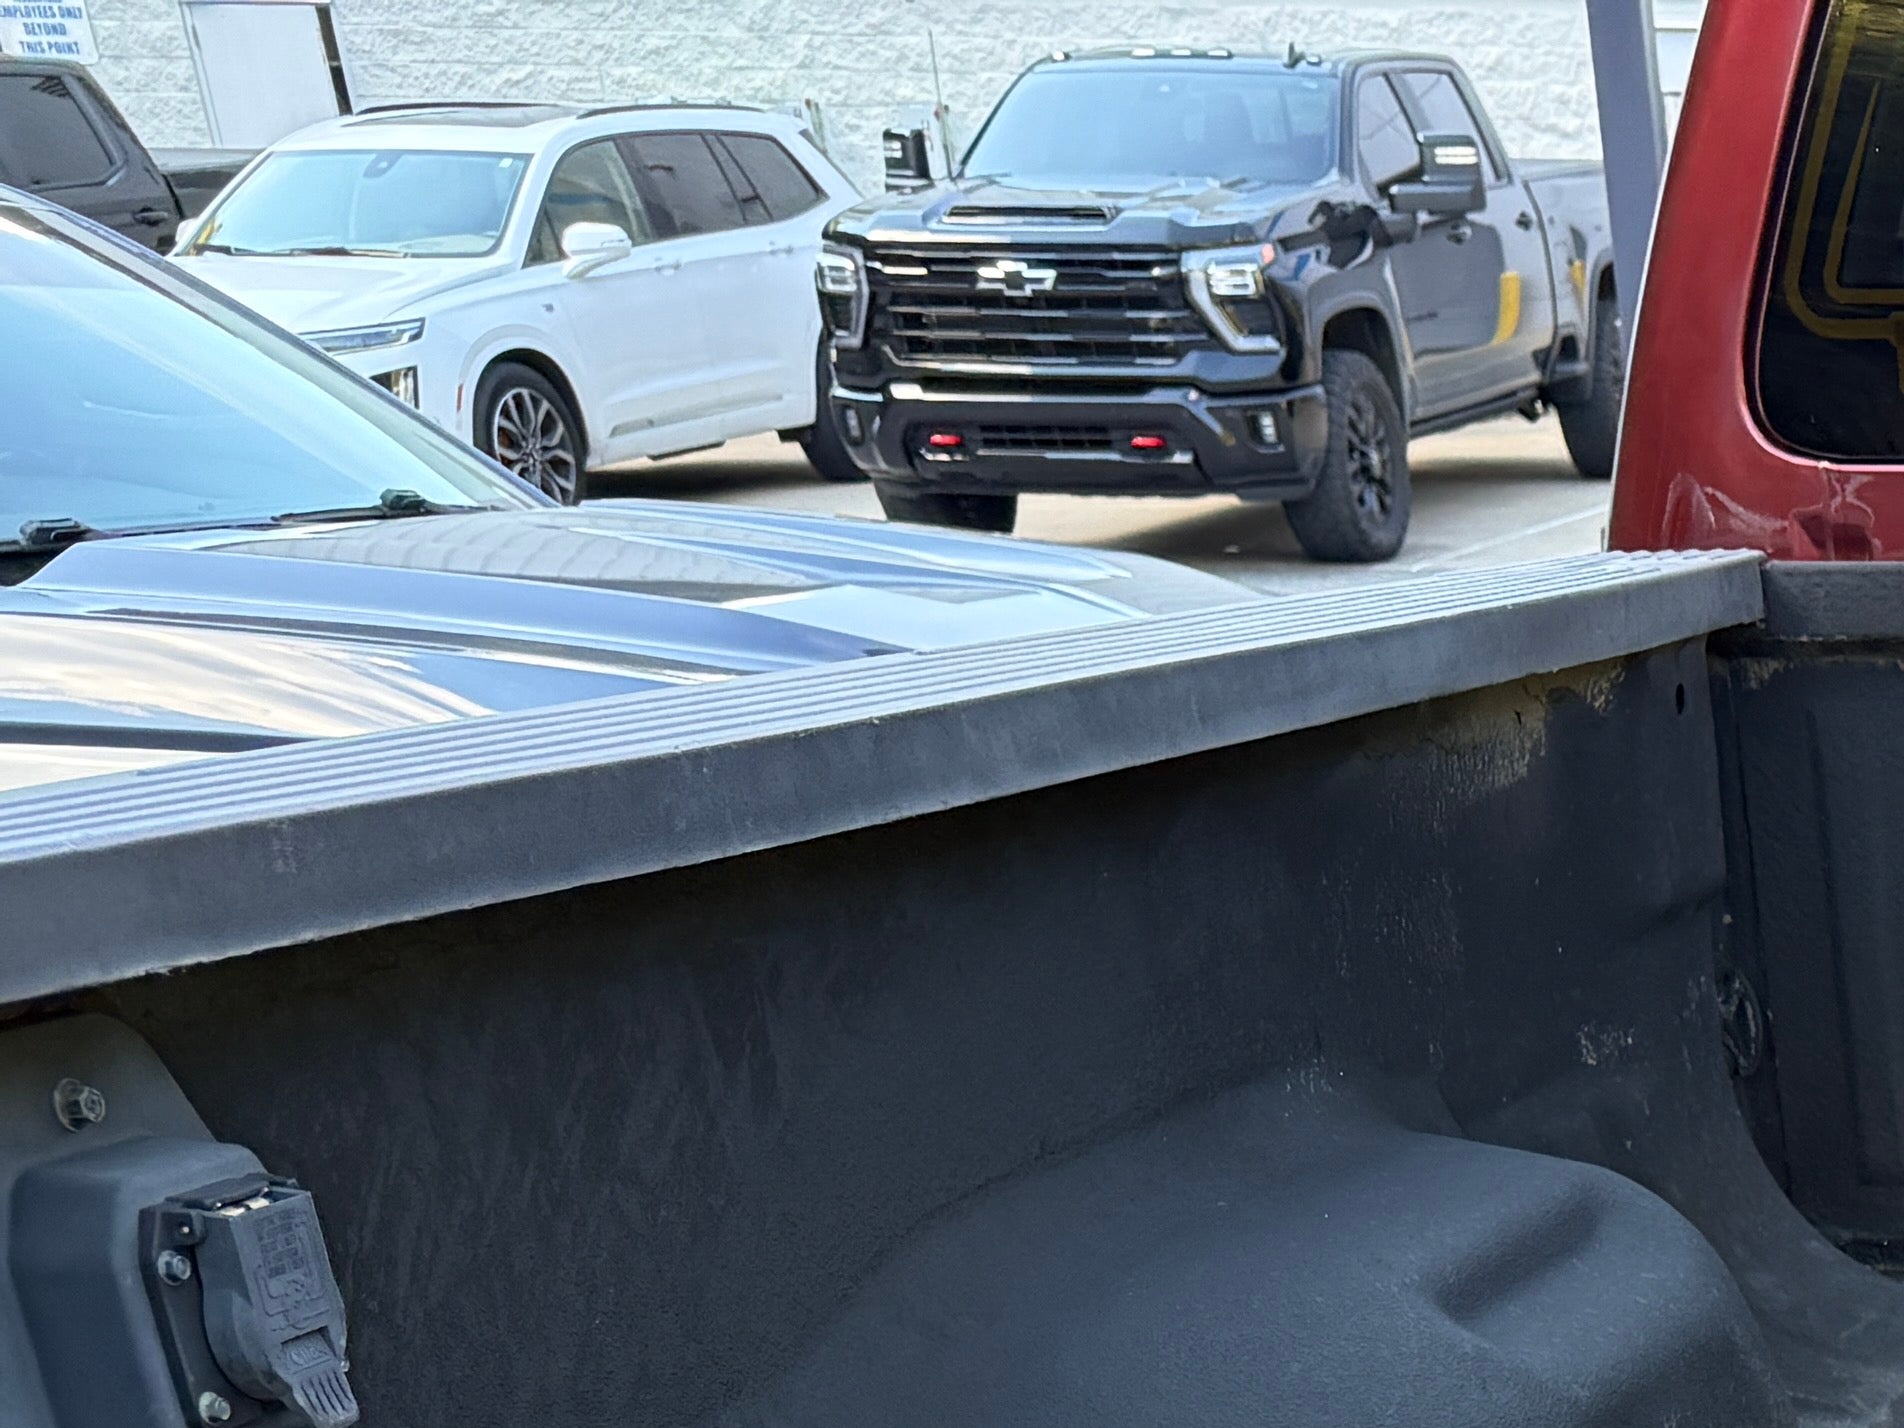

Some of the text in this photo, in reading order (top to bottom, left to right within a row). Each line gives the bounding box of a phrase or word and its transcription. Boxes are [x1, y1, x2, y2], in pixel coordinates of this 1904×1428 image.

[58, 6, 82, 19] ONLY
[23, 22, 67, 36] BEYOND
[19, 41, 80, 55] THIS POINT
